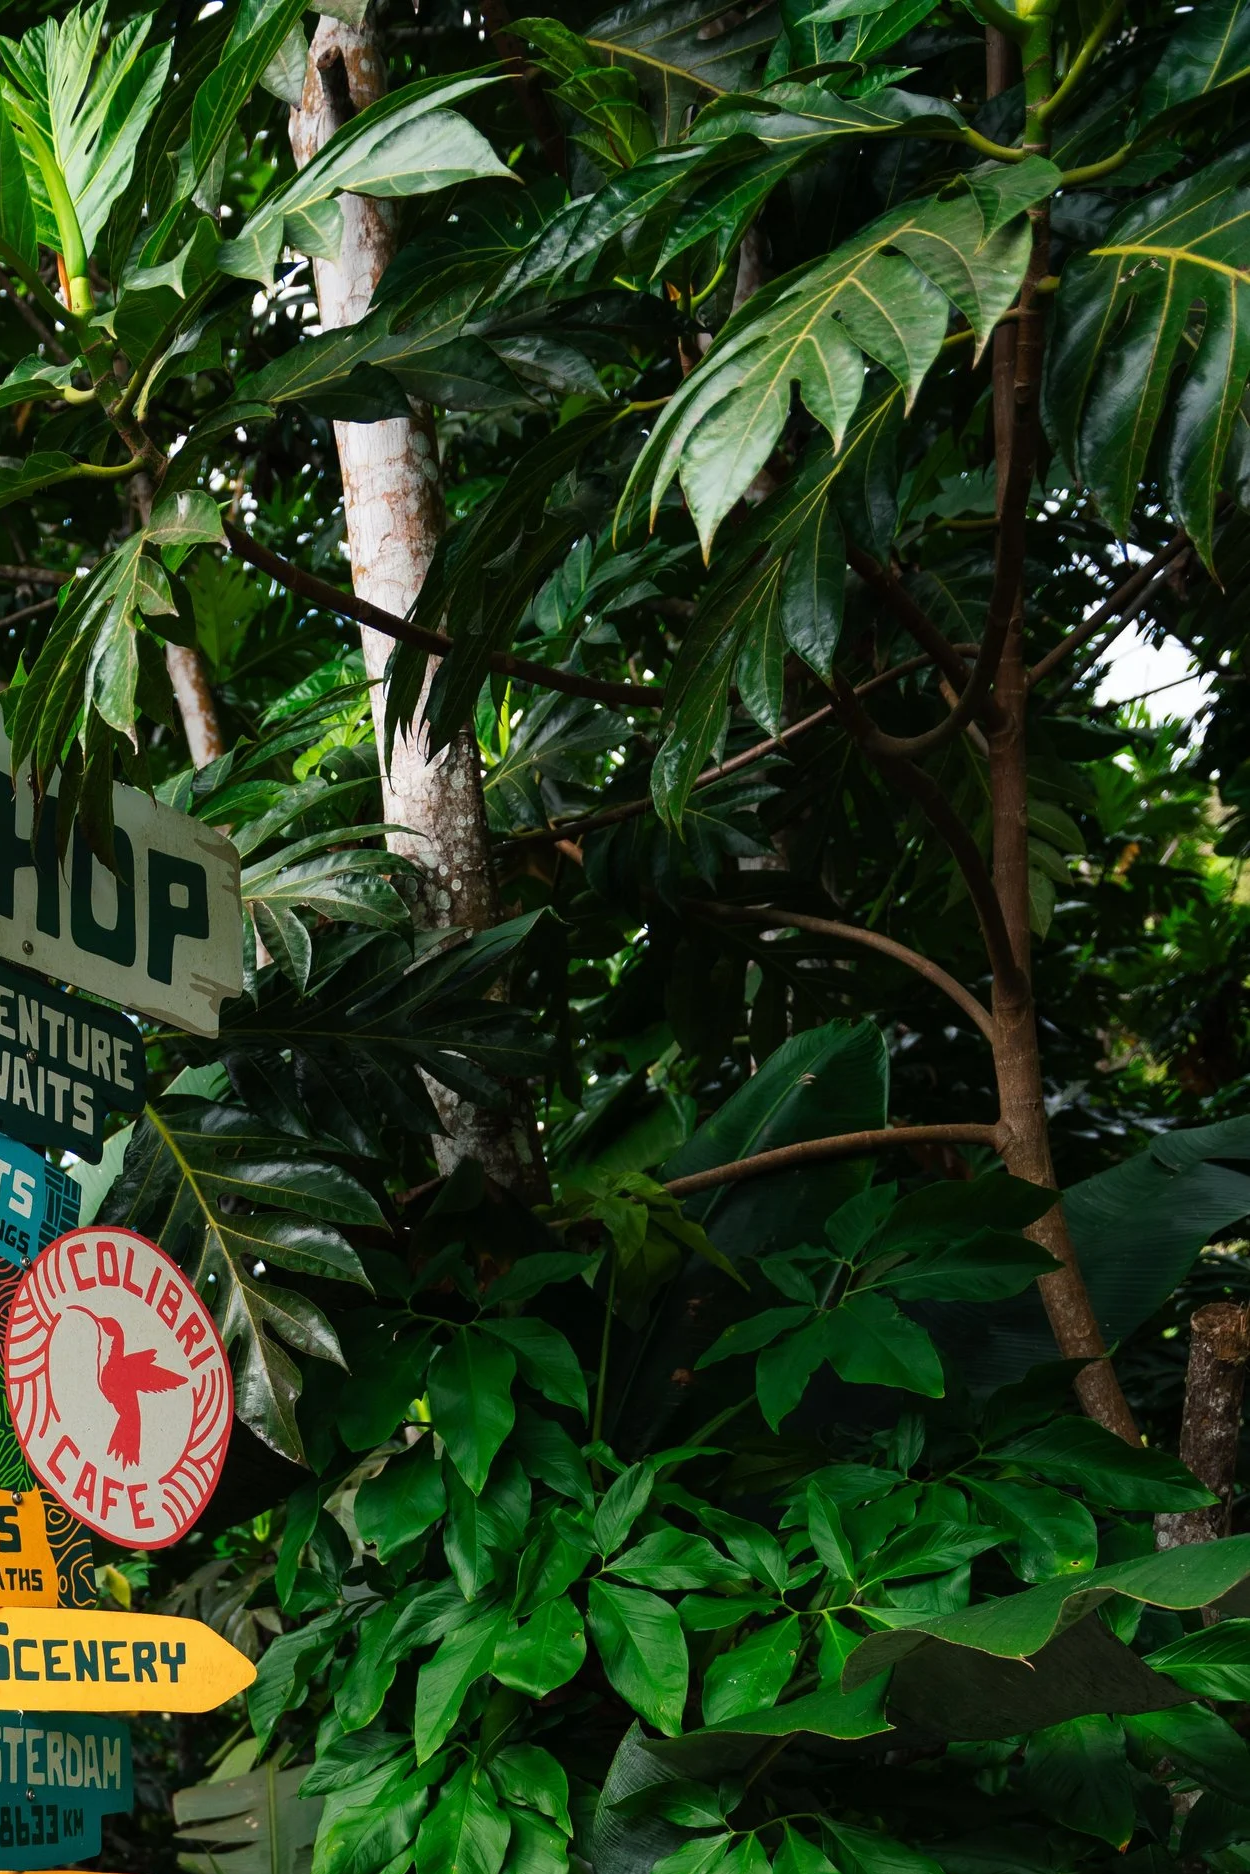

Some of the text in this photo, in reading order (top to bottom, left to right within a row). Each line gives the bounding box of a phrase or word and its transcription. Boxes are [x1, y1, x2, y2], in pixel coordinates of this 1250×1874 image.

[66, 1243, 216, 1370] COLIBRI
[49, 1434, 155, 1530] CAFE
[63, 1811, 84, 1838] KM
